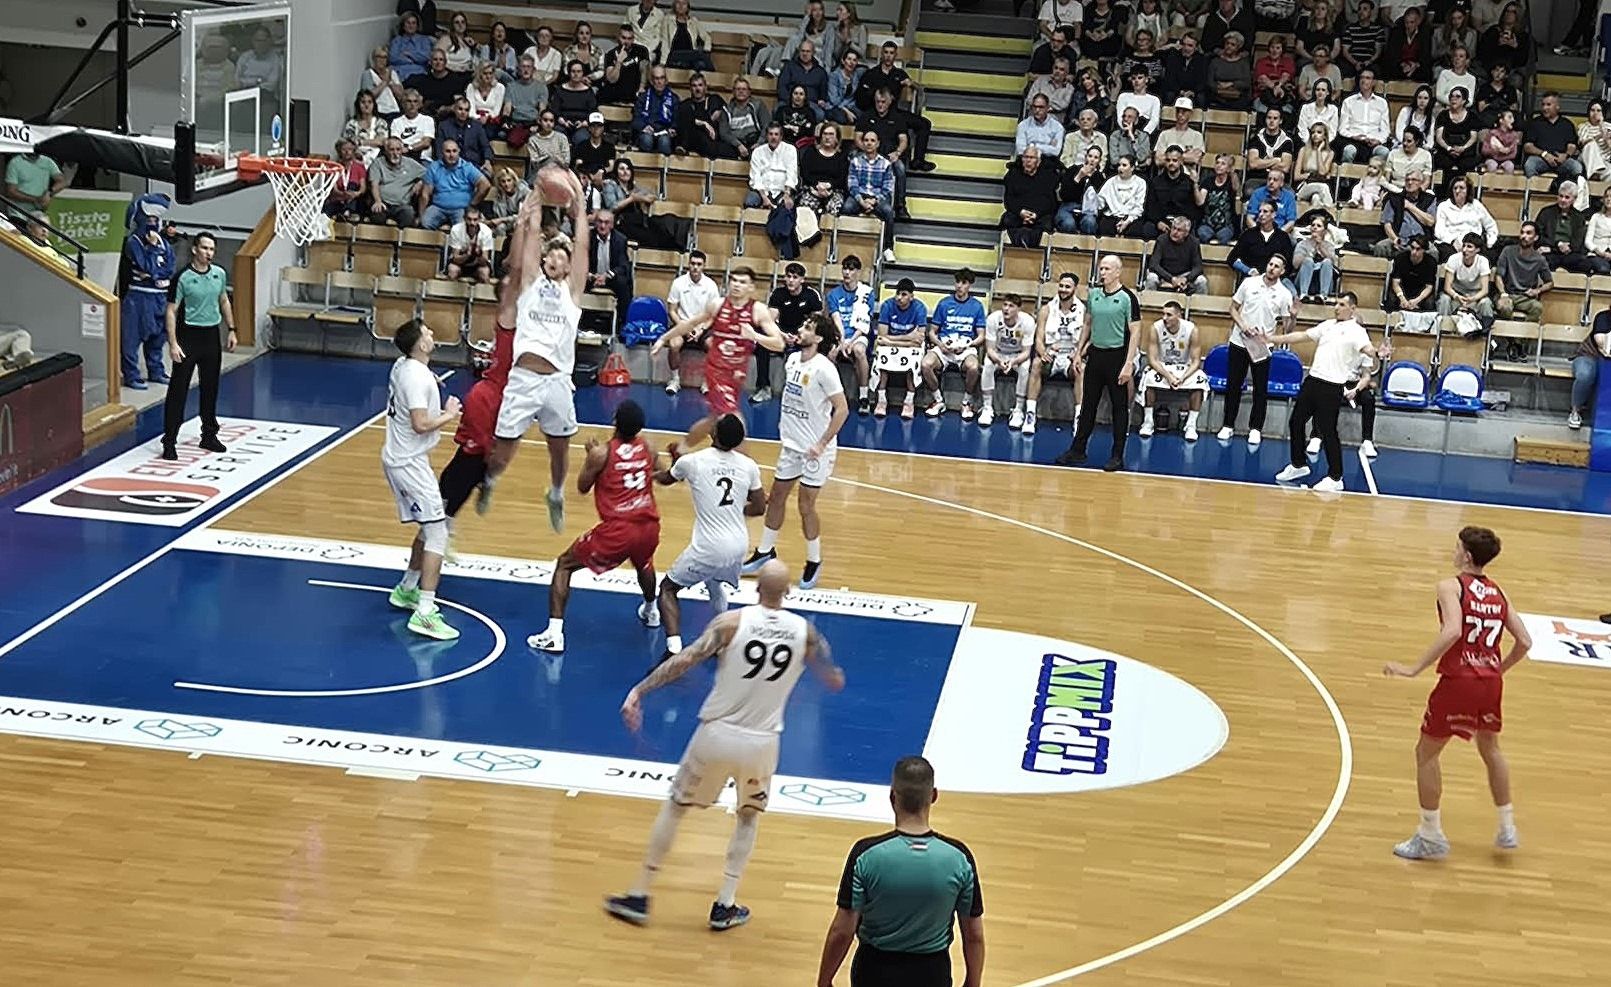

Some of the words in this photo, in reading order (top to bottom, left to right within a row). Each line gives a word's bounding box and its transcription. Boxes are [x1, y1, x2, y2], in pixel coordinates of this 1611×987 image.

[0, 125, 30, 143] ING
[58, 211, 111, 224] Tiszta
[187, 427, 301, 481] SERVICE
[716, 476, 735, 507] 2
[216, 539, 315, 554] DEPONIA
[784, 594, 885, 611] DEPONIA
[1465, 615, 1503, 648] 77
[742, 639, 792, 682] 99
[0, 706, 123, 727] ARCON
[283, 735, 440, 758] ARCONIC
